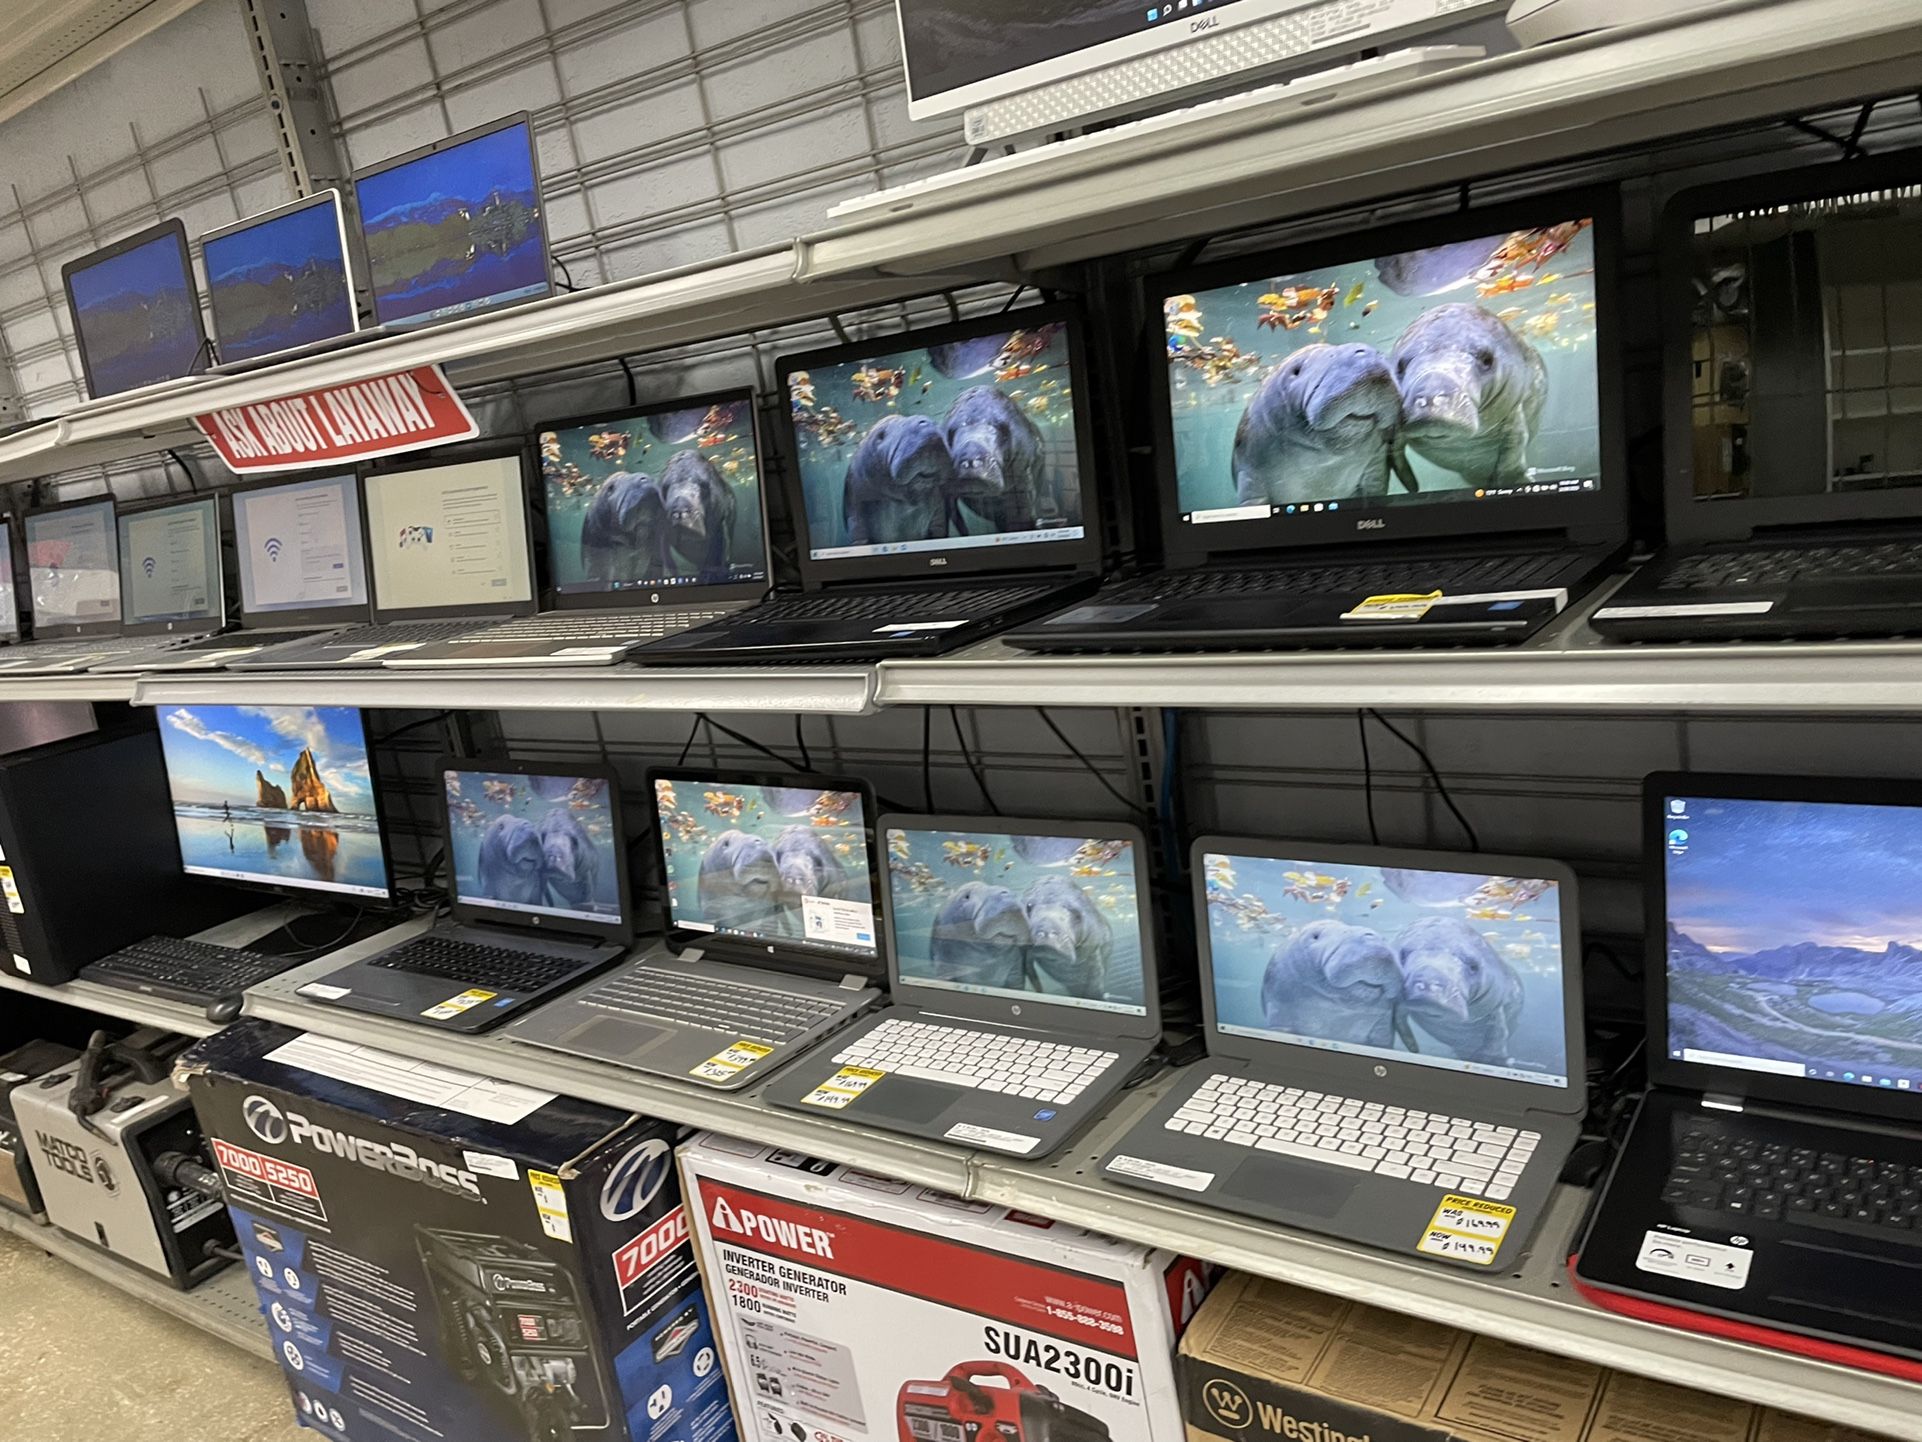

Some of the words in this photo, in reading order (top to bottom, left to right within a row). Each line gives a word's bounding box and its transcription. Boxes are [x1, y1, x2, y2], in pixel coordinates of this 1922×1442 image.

[1189, 16, 1220, 33] DELL
[212, 408, 269, 459] ASK
[248, 396, 328, 456] ABOUT
[323, 371, 436, 448] LAYAWAY
[1356, 518, 1386, 530] DELL
[35, 1129, 88, 1164] MATCO
[41, 1148, 94, 1183] TOOLS
[217, 1145, 262, 1177] 7000
[265, 1162, 312, 1193] 5250
[1442, 1208, 1463, 1216] WAS
[1446, 1196, 1472, 1208] PRICE
[1473, 1201, 1513, 1215] REDUCED
[1429, 1231, 1452, 1240] NOW
[723, 1249, 776, 1275] INVERTER
[779, 1263, 848, 1296] GENERATOR
[725, 1263, 781, 1290] GENERADOR
[783, 1280, 830, 1304] INVERTER
[728, 1278, 759, 1298] 2300
[731, 1294, 762, 1314] 1800
[984, 1326, 1135, 1396] SUA2300i
